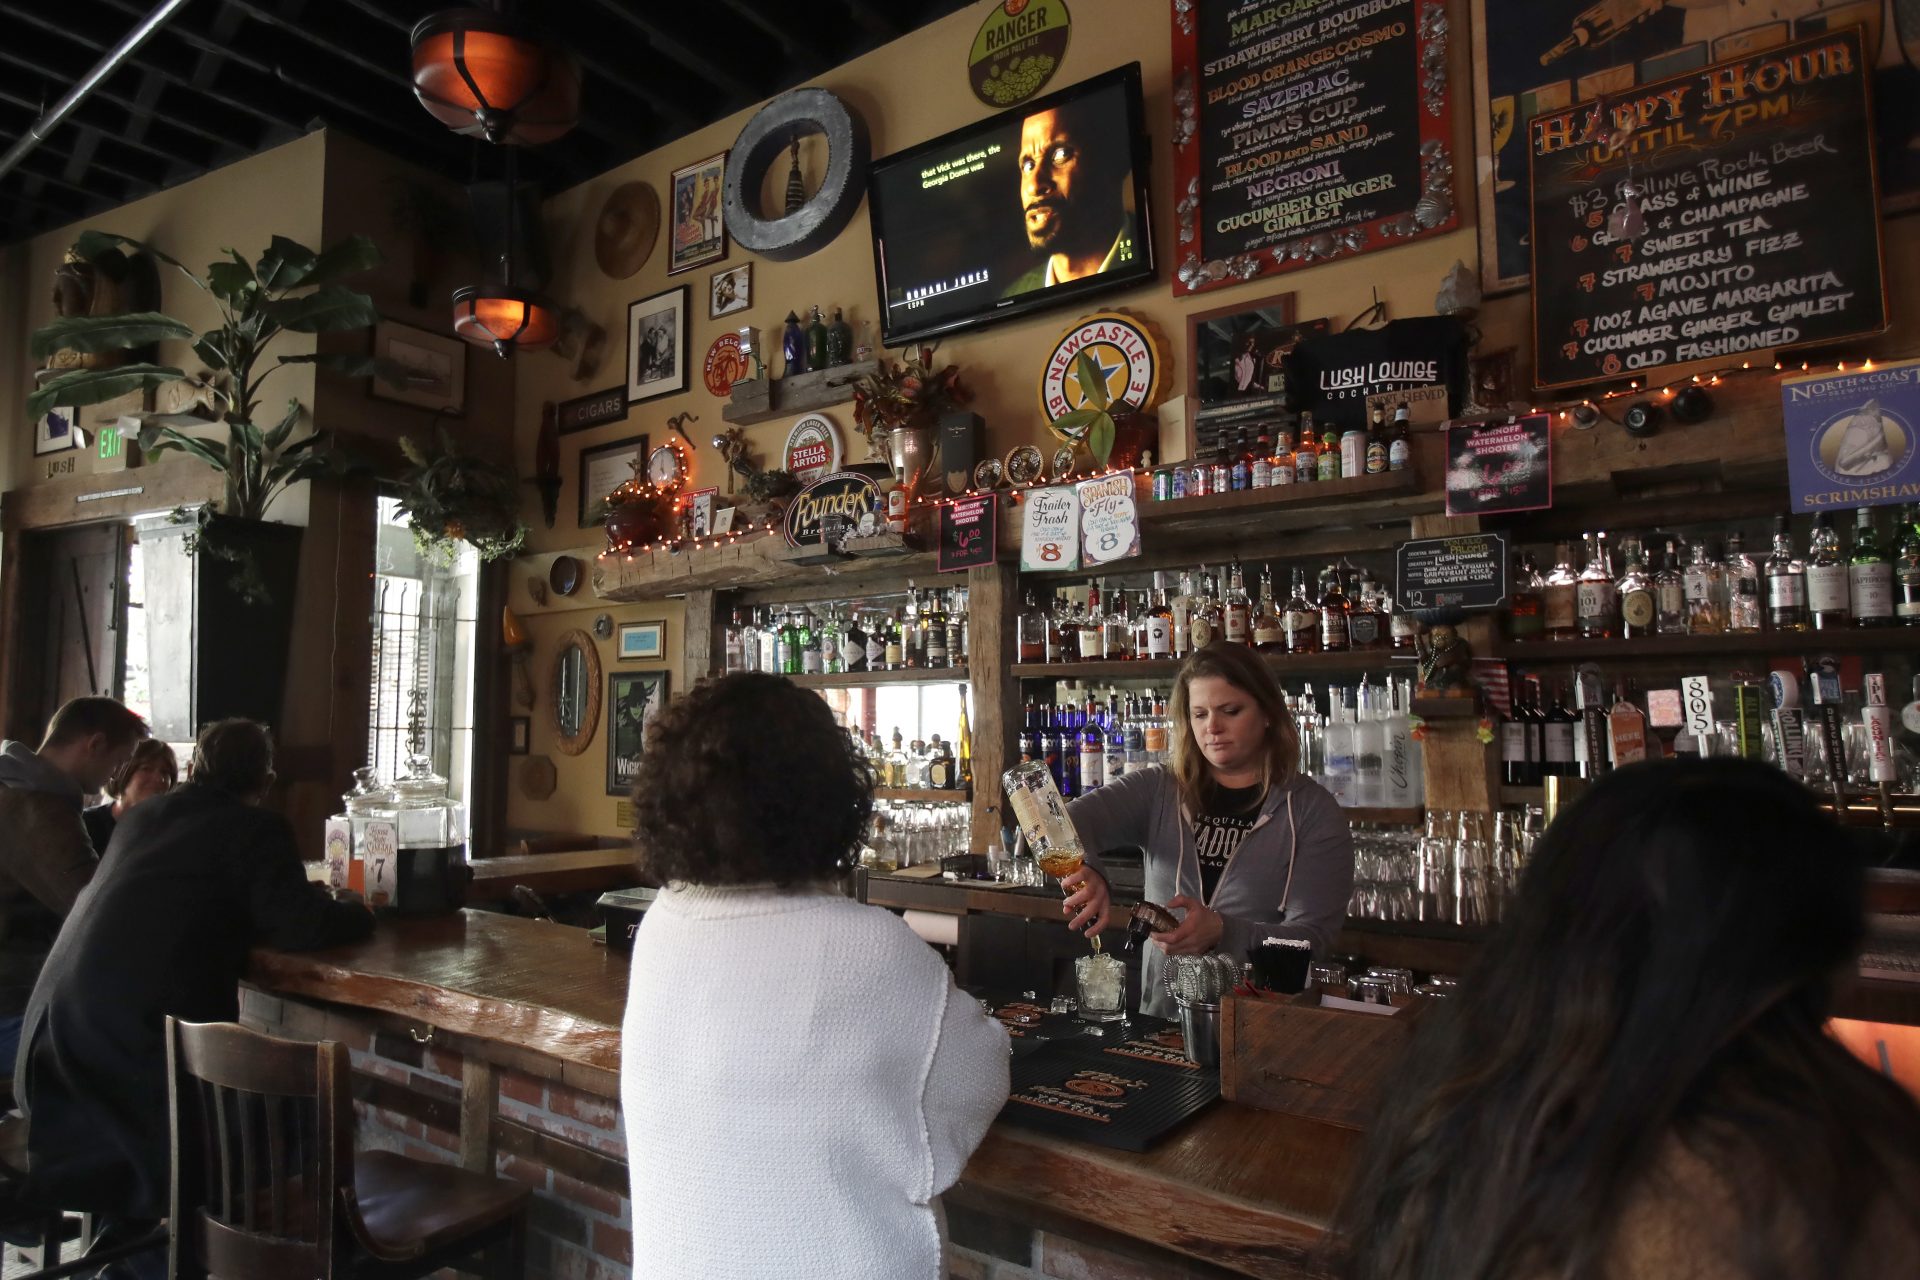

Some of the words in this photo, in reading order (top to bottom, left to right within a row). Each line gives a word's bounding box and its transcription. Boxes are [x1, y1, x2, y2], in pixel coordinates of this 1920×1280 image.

[986, 7, 1047, 51] RANGER
[1204, 22, 1316, 77] STRAWBERRY
[1207, 72, 1261, 106] BLOOD
[1261, 46, 1336, 83] ORANGE
[1334, 22, 1407, 56] COSMO
[1702, 43, 1854, 110] HOUR
[1242, 68, 1350, 119] SAZERAC
[1232, 113, 1304, 150] PIMM'S
[1308, 96, 1359, 124] CUP
[921, 166, 937, 180] that
[937, 163, 952, 174] Vick
[952, 158, 966, 169] was
[966, 150, 987, 164] there,
[987, 144, 1001, 156] the
[1225, 150, 1282, 181] BLOOD
[1282, 145, 1311, 162] AND
[1309, 123, 1369, 153] SAND
[922, 175, 949, 190] Georgia
[949, 167, 970, 180] Dome
[970, 162, 985, 173] was
[1246, 159, 1342, 201] NEGRONI
[1568, 188, 1609, 219] $3
[1699, 151, 1768, 182] Rock
[1216, 194, 1314, 234] CUCUMBER
[1314, 173, 1397, 207] GINGER
[1586, 209, 1604, 229] 5
[1613, 191, 1679, 216] GASS
[1686, 189, 1700, 202] of
[1707, 170, 1772, 199] WINE
[1658, 216, 1673, 230] of
[1679, 184, 1810, 227] CHAMPAGNE
[1263, 202, 1345, 234] GIMLET
[1615, 244, 1633, 264] 7
[1640, 226, 1715, 257] SWEET
[1723, 214, 1773, 240] TEA
[1577, 272, 1596, 293] 7
[1601, 246, 1732, 288] STRAWBERRY
[1746, 231, 1804, 257] FIZZ
[953, 269, 989, 289] JONES
[1634, 282, 1655, 302] 7
[1659, 264, 1754, 298] MOJITO
[1571, 318, 1590, 338] 7
[1593, 309, 1632, 333] 100%
[1638, 297, 1708, 325] AGAVE
[1711, 270, 1844, 310] MARGARITA
[1561, 341, 1579, 361] 7
[1583, 322, 1678, 356] CUCUMBER
[1681, 310, 1762, 339] GINGER
[1767, 291, 1855, 324] GIMLET
[706, 347, 717, 372] NEW
[1049, 325, 1146, 382] NEWCASTLE
[1601, 353, 1622, 375] 8
[1626, 348, 1667, 370] OLD
[1676, 326, 1800, 362] FASHIONED
[1320, 365, 1365, 390] LUSH
[1368, 360, 1438, 384] LOUNGE
[1789, 376, 1858, 402] NORTH
[577, 397, 621, 421] CIGARS
[1401, 388, 1445, 403] SLEEVED
[792, 445, 826, 460] STELLA
[1466, 432, 1529, 447] WATERMELON
[1475, 442, 1519, 455] SHOOTER
[792, 453, 827, 469] ARTOIS
[1033, 496, 1071, 512] Trailer
[1082, 478, 1128, 508] SPANISH
[1092, 496, 1117, 518] Fly
[802, 523, 853, 536] Brewing
[955, 515, 979, 526] SHOOTER
[1032, 509, 1069, 528] Trash
[1435, 555, 1456, 566] LUSH
[1455, 551, 1489, 565] LOUNGE
[1450, 543, 1488, 555] PALOMA
[1443, 575, 1468, 583] WATER
[1406, 590, 1427, 607] $12
[1580, 597, 1598, 607] 101
[1688, 681, 1709, 731] 805
[1389, 732, 1408, 789] Chopin
[1196, 813, 1254, 827] TEQUILA
